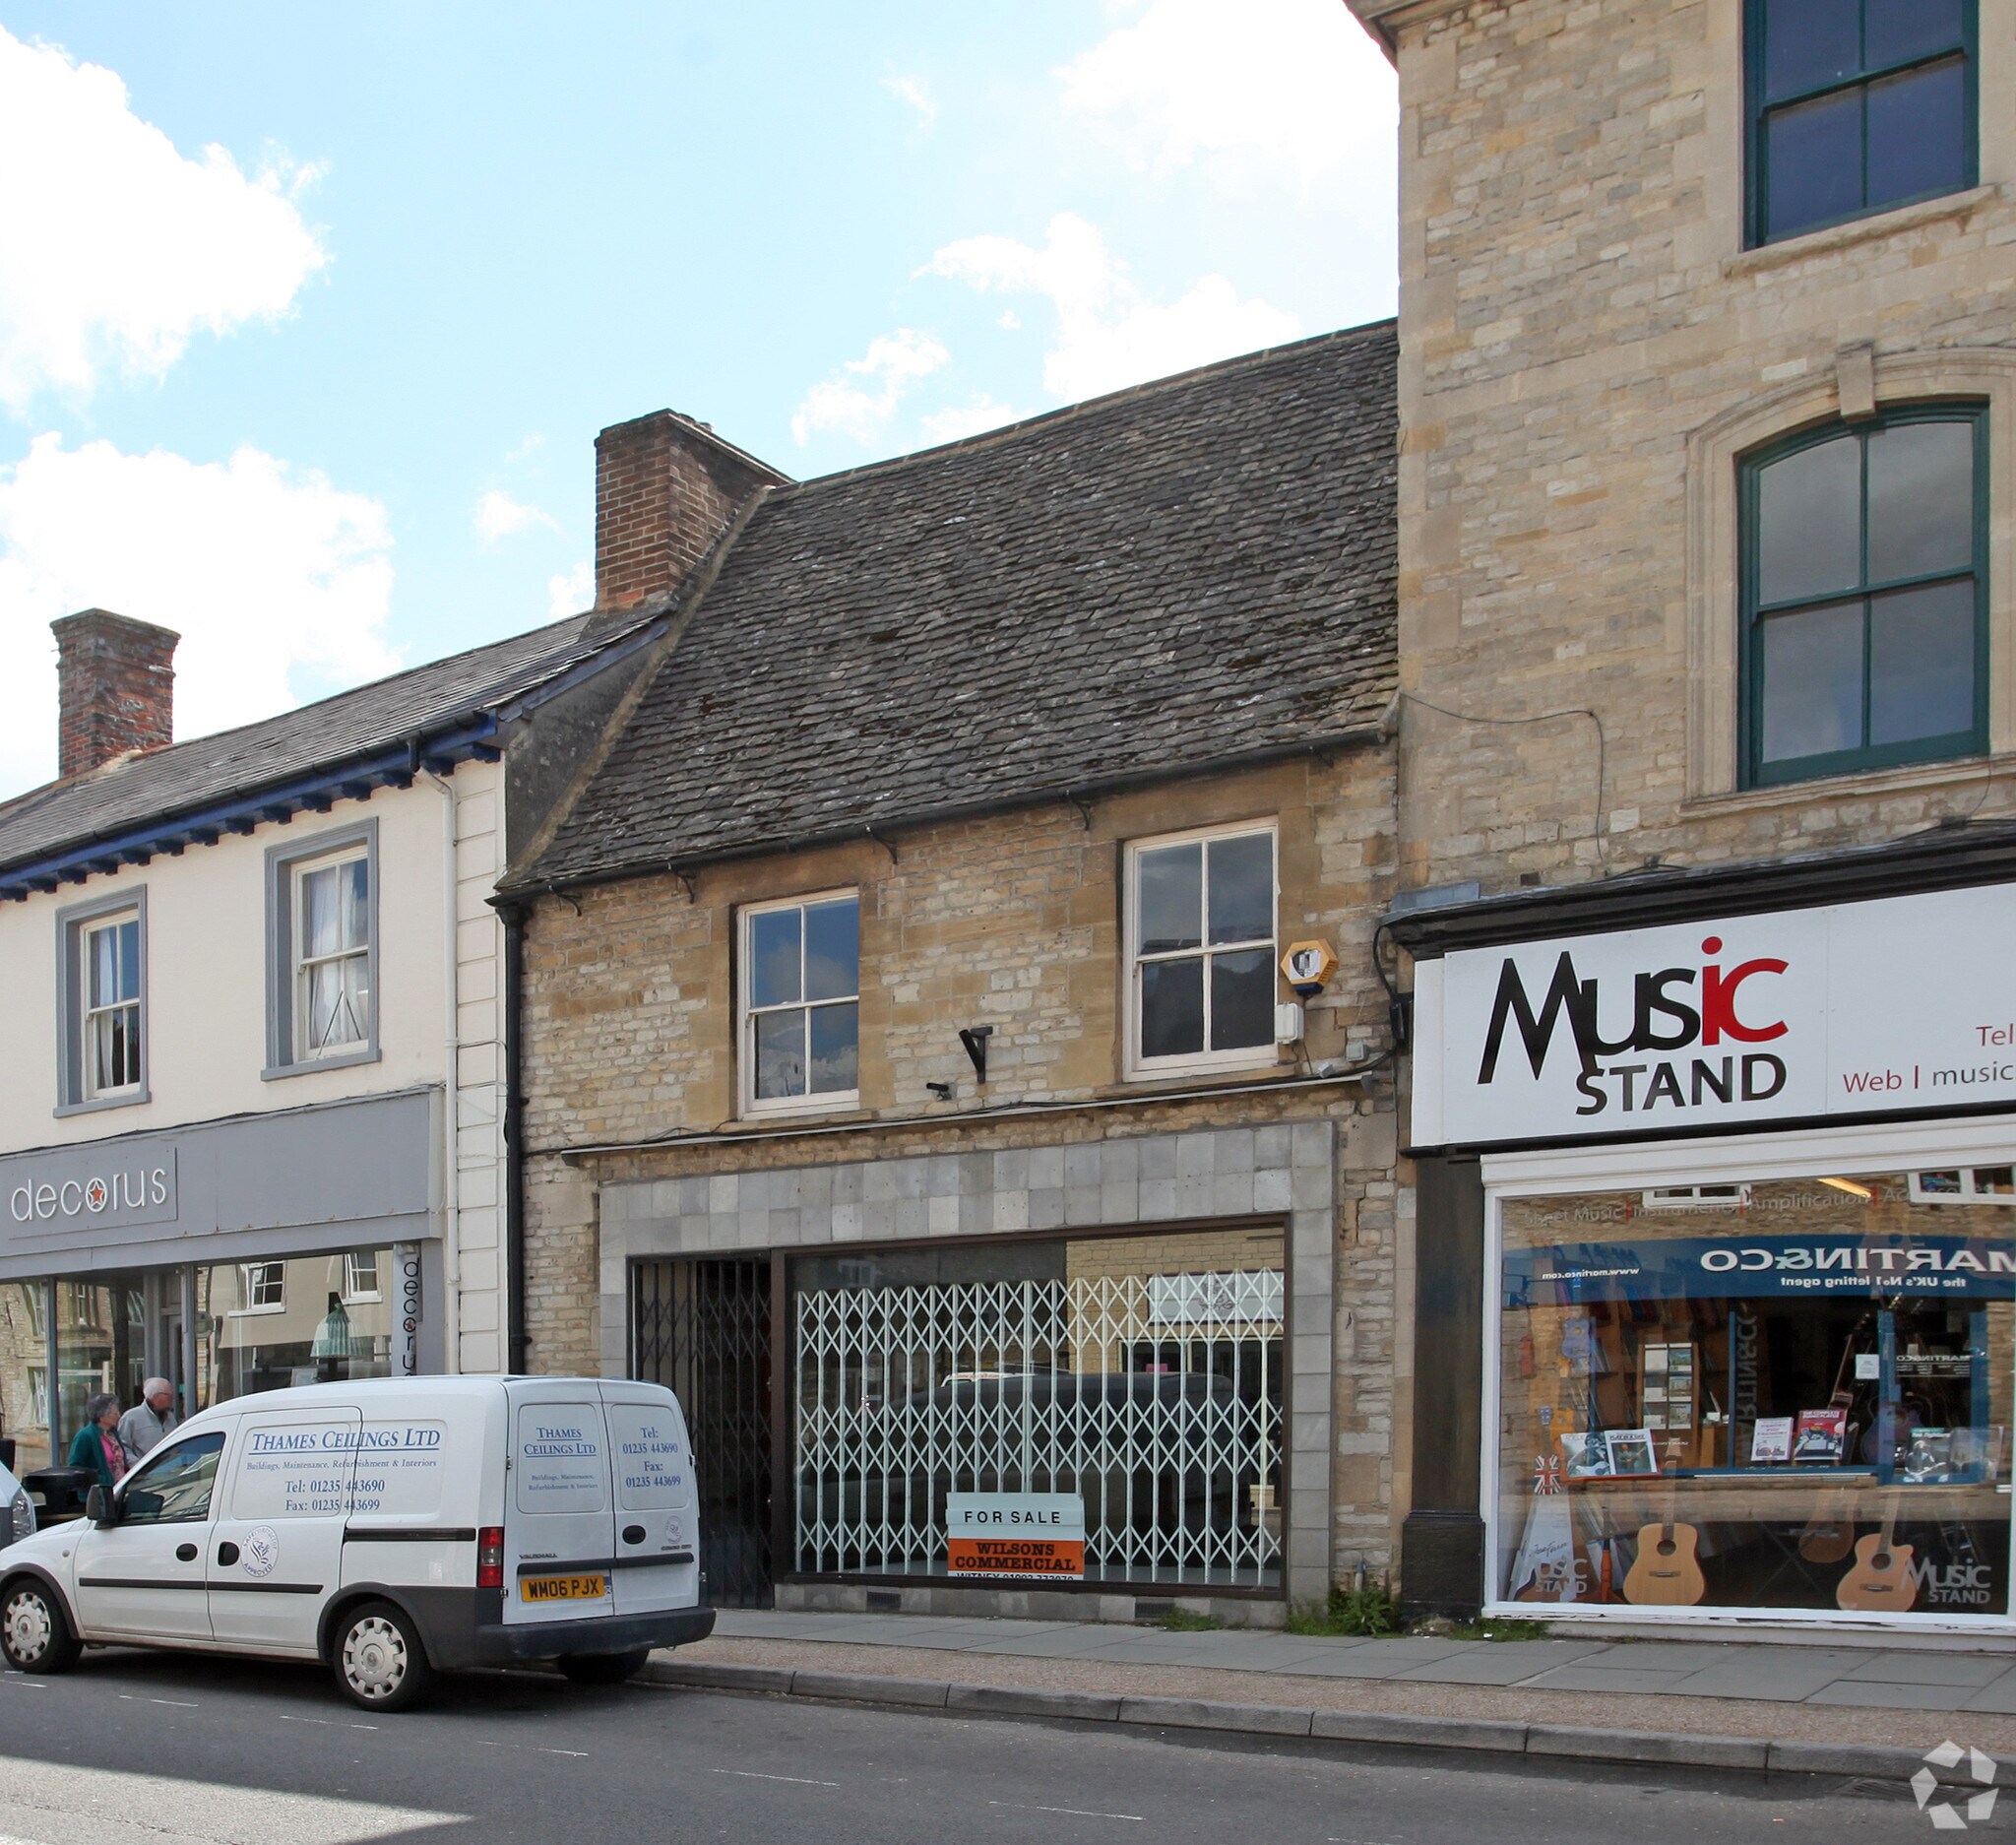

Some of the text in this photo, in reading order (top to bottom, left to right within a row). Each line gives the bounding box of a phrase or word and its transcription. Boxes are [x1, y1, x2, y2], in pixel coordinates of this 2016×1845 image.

[1976, 1023, 2014, 1047] Tel
[1575, 1052, 1788, 1115] STAND
[1843, 1069, 1903, 1094] Web
[11, 1168, 167, 1223] decorus
[1575, 1205, 1621, 1223] Music
[1749, 1189, 1869, 1212] Amplification
[403, 1257, 419, 1377] decoru
[252, 1429, 441, 1451] THAMES CEILINGS LTD
[536, 1428, 583, 1438] THAMES
[640, 1428, 659, 1439] Tel:
[524, 1444, 597, 1455] CEILINGS LTD
[622, 1443, 678, 1454] 01235 443690
[402, 1459, 437, 1468] Interiors
[644, 1461, 663, 1471] Fax:
[284, 1480, 385, 1494] Tel: 01235 443690
[626, 1477, 681, 1488] 01235 443699
[284, 1499, 380, 1511] Fax: 01235 443699
[965, 1511, 1061, 1523] FOR SALE
[976, 1543, 1055, 1556] WILSONS
[955, 1557, 1076, 1571] COMMERCIAL
[529, 1579, 599, 1598] WM06 PJX
[1929, 1589, 1991, 1604] STAND
